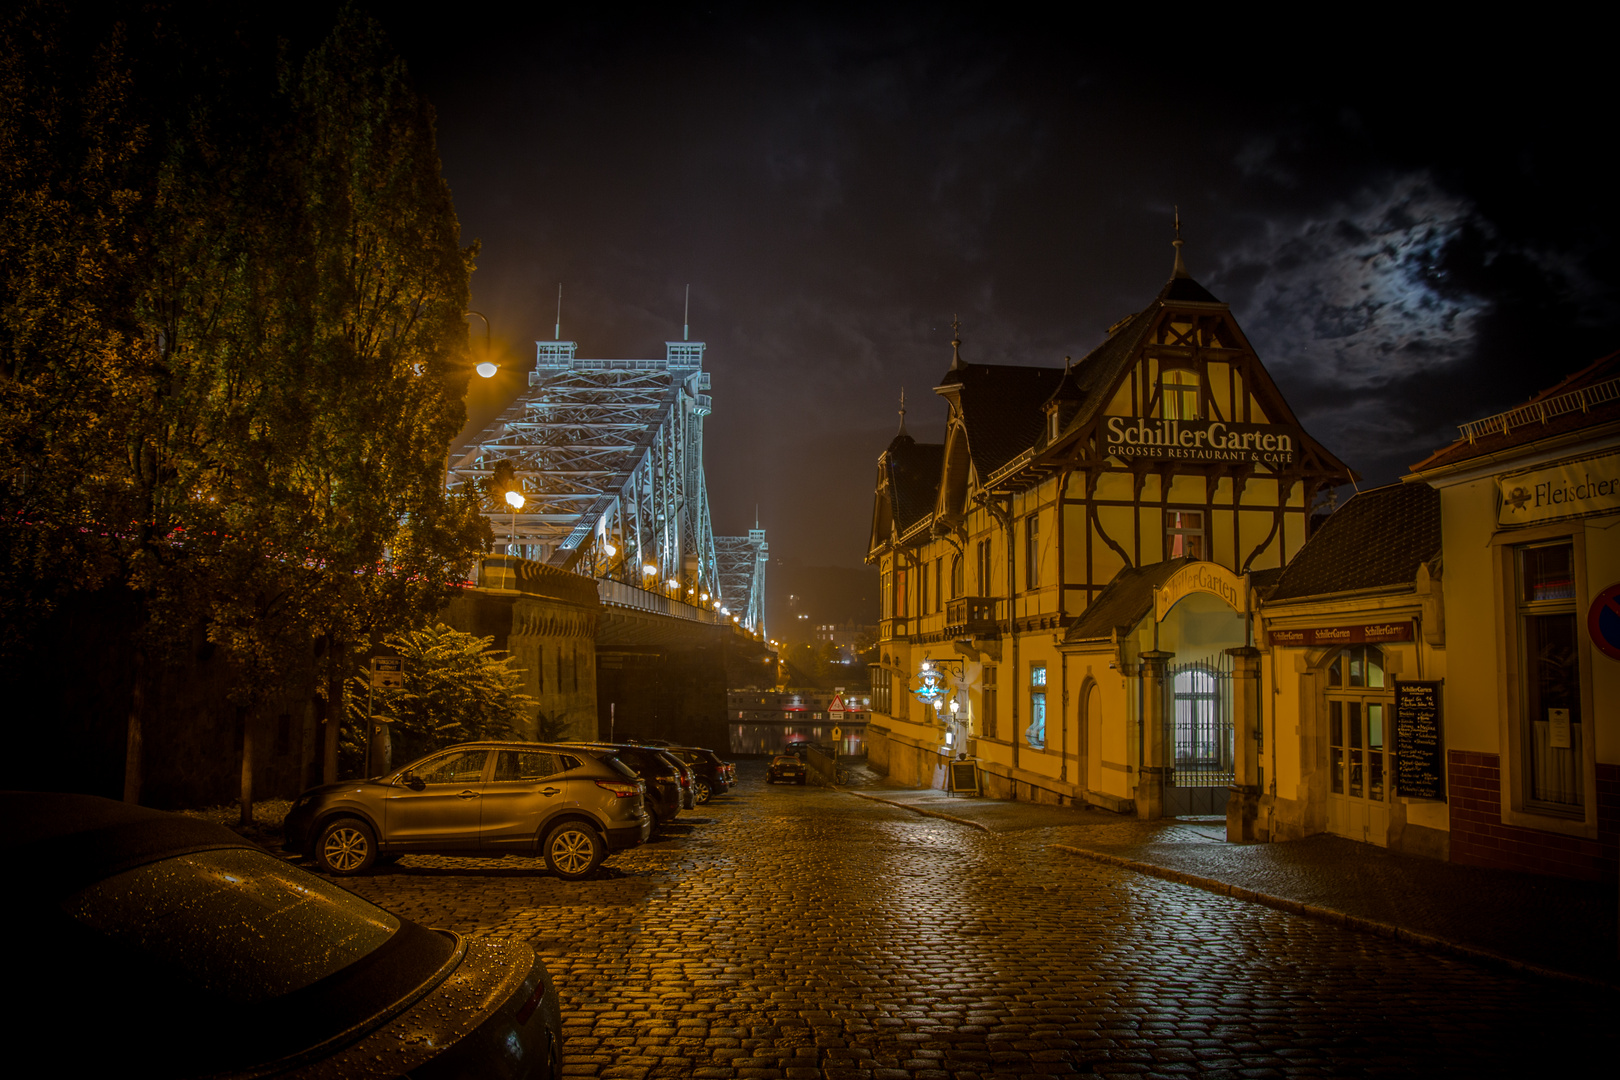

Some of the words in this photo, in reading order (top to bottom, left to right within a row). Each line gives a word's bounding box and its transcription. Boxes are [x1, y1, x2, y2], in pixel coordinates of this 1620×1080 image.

[1107, 416, 1293, 453] SchillerGarten
[1108, 445, 1162, 457] GROSSES
[1168, 448, 1247, 461] RESTAURANT
[1251, 453, 1259, 461] &
[1264, 452, 1293, 463] CAFÉ
[1534, 473, 1619, 508] Fleischer
[1273, 631, 1304, 640] SchillerGarten
[1315, 628, 1351, 639] SchillerGarten
